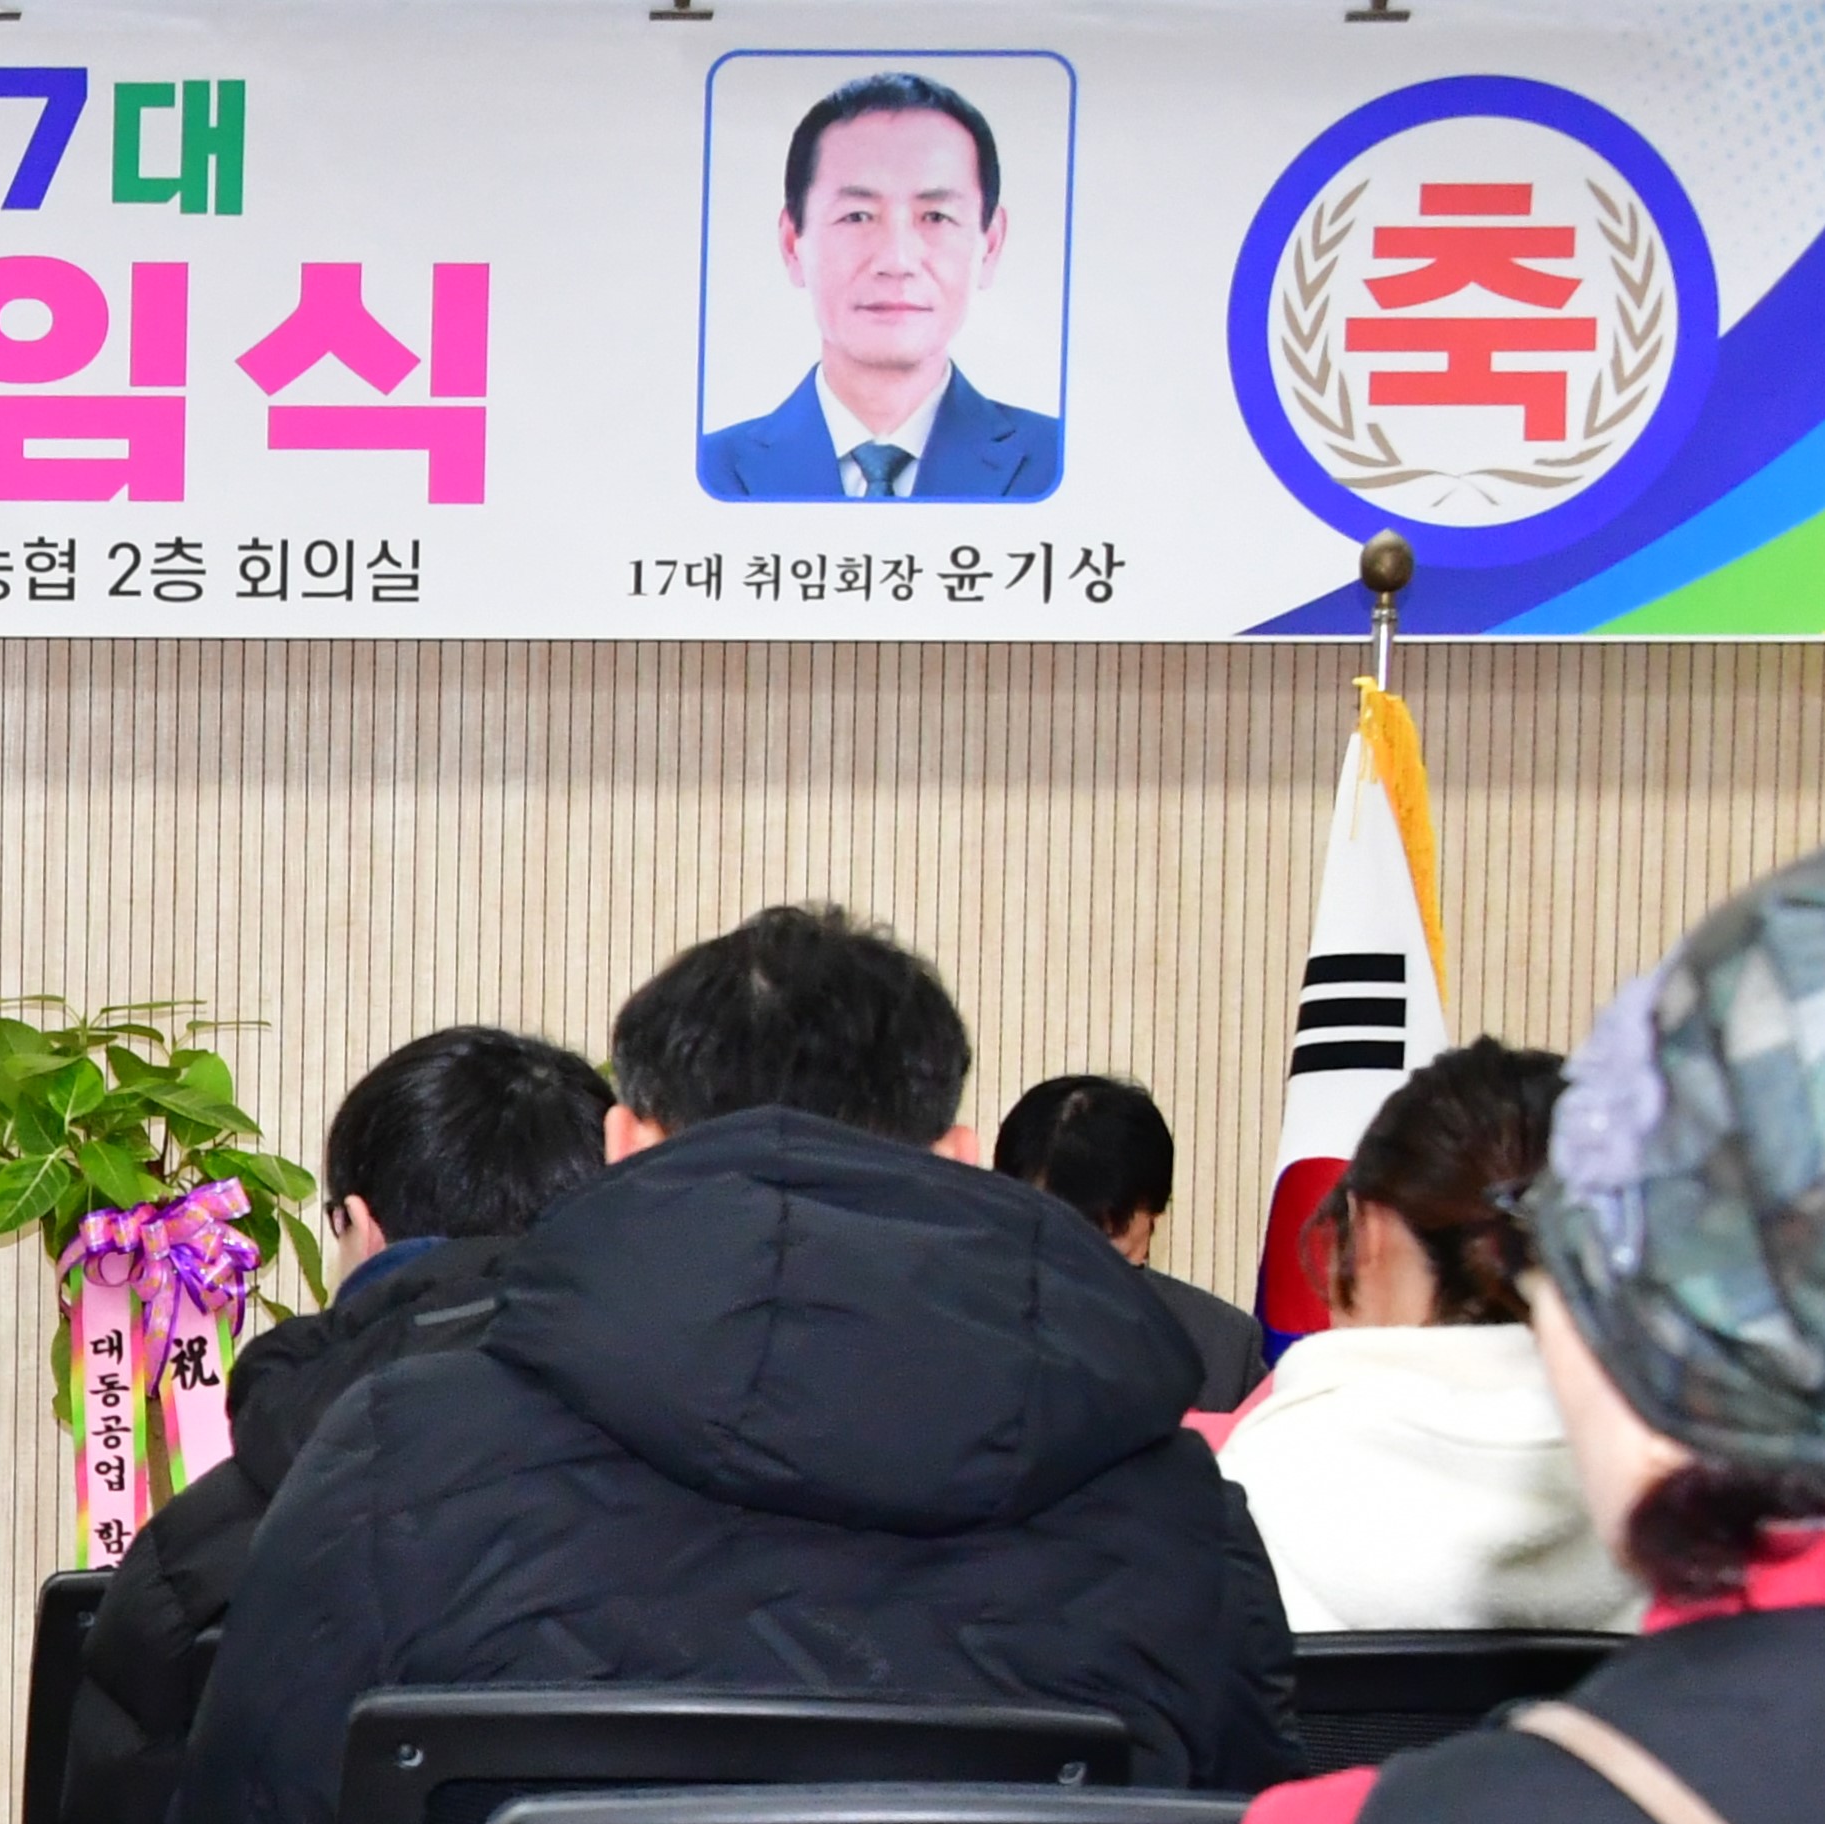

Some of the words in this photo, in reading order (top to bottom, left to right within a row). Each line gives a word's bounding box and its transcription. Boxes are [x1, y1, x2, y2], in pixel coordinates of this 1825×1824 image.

[1344, 182, 1597, 441] 축
[109, 537, 205, 602] 2층
[237, 538, 419, 601] 회의실
[628, 555, 722, 600] 17대
[746, 555, 922, 600] 취임회장
[937, 542, 1126, 604] 윤기상
[171, 1335, 220, 1390] 祝
[89, 1328, 133, 1492] 대동공업
